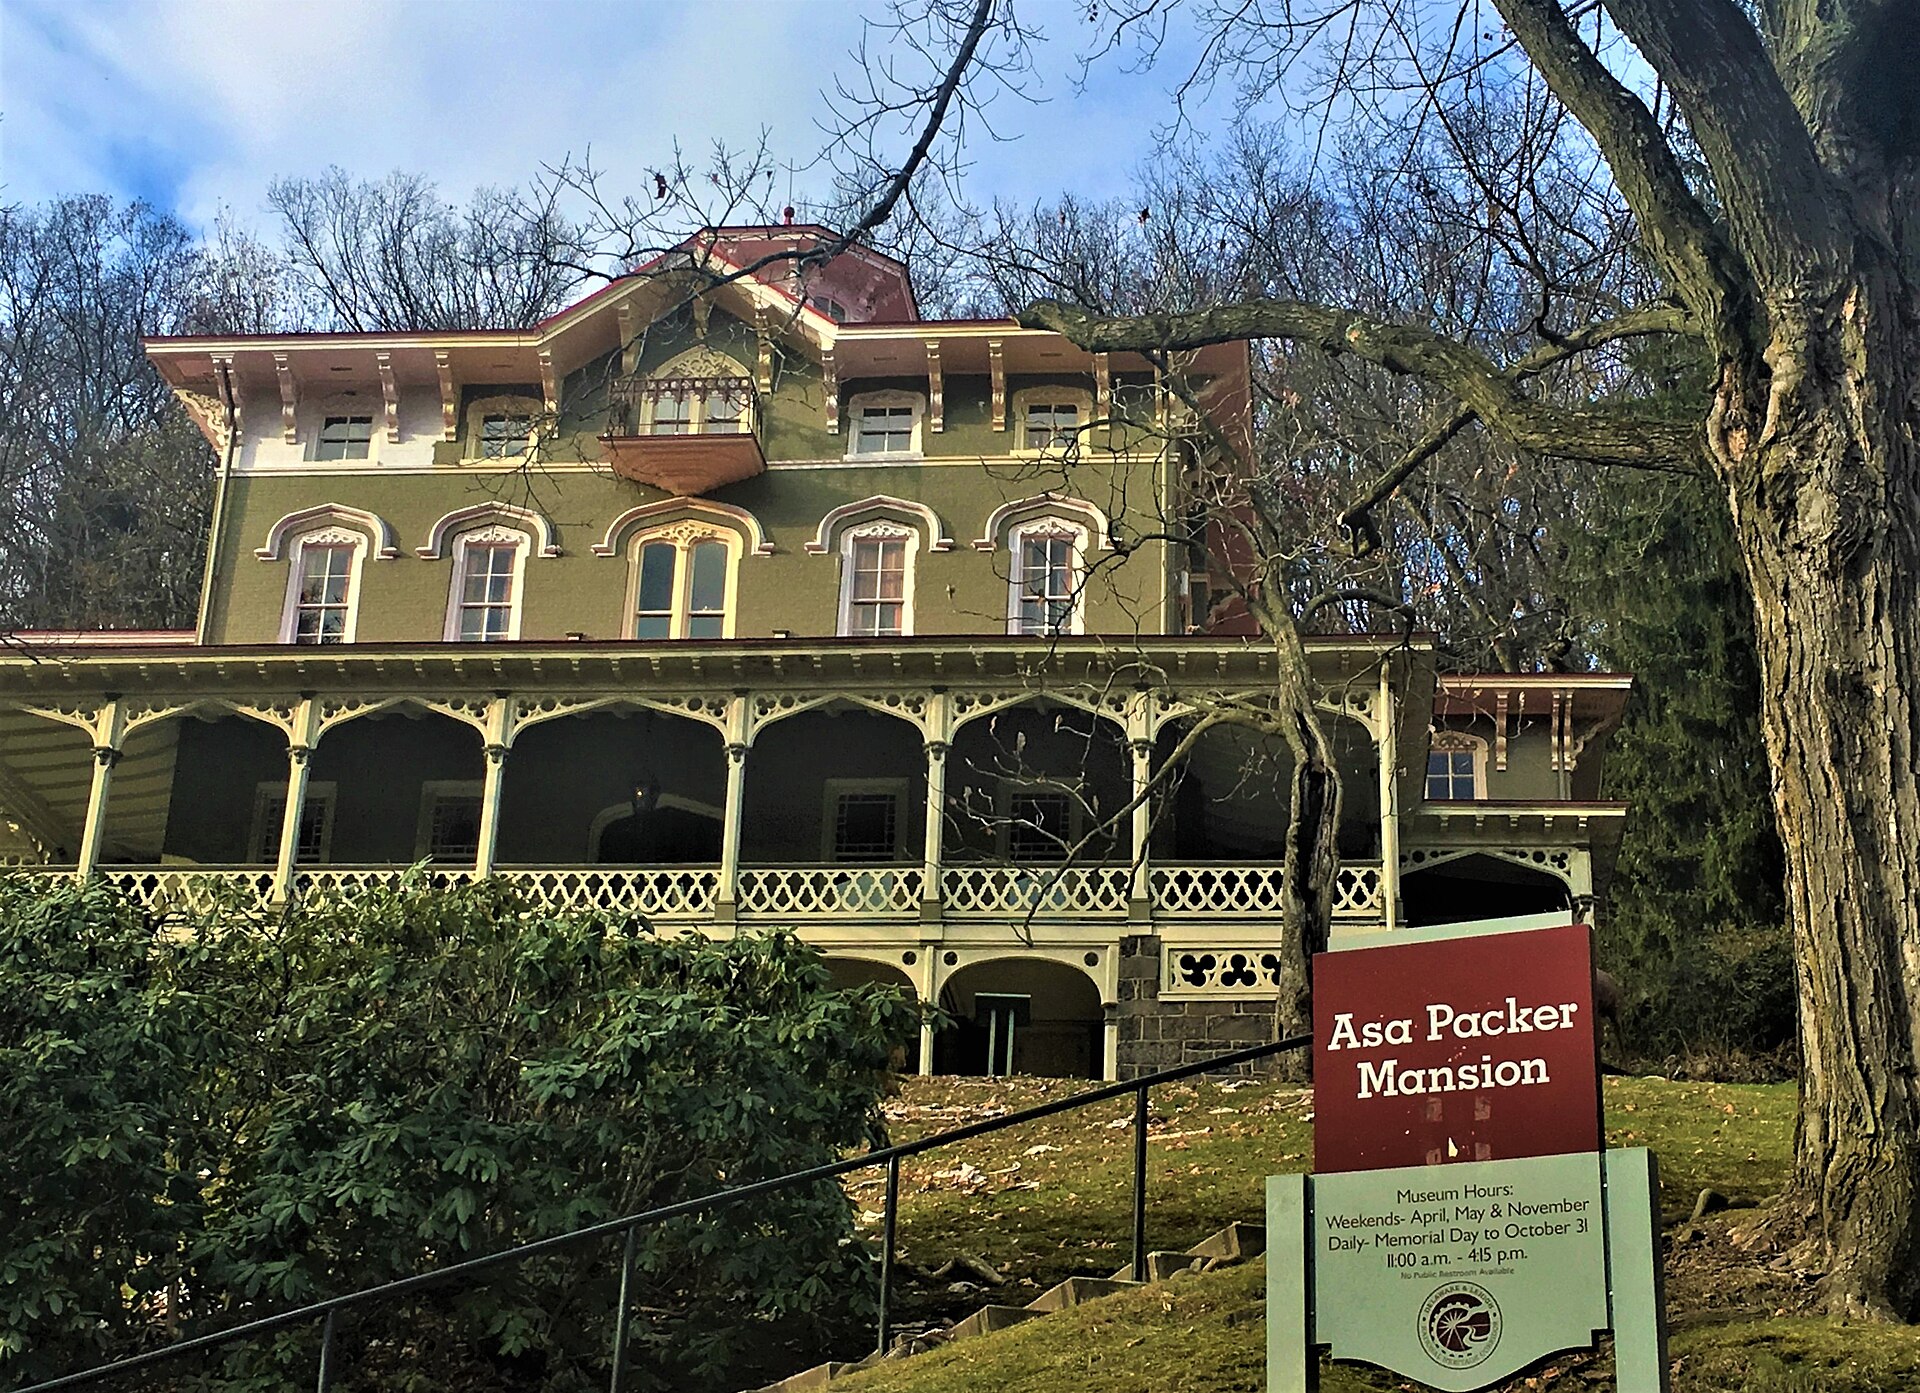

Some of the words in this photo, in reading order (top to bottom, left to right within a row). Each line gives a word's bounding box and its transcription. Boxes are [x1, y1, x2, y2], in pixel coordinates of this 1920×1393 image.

[1327, 1013, 1413, 1050] Asa
[1426, 997, 1578, 1042] Packer
[1357, 1055, 1550, 1099] Mansion
[1397, 1189, 1459, 1204] Museum
[1464, 1184, 1513, 1199] Hours:
[1325, 1212, 1406, 1229] Weekends-
[1410, 1208, 1450, 1227] April,
[1455, 1206, 1485, 1224] May
[1490, 1203, 1502, 1218] &
[1508, 1198, 1589, 1217] November
[1328, 1235, 1369, 1253] Daily-
[1375, 1229, 1444, 1247] Memorial
[1450, 1228, 1479, 1245] Day
[1484, 1229, 1500, 1240] to
[1505, 1221, 1571, 1238] October
[1576, 1218, 1588, 1233] 31
[1387, 1252, 1416, 1268] 11:00
[1421, 1254, 1451, 1266] a.m.
[1468, 1247, 1492, 1262] 4:15
[1497, 1249, 1528, 1265] p.m.
[1401, 1271, 1411, 1279] No
[1414, 1271, 1437, 1279] Public
[1479, 1267, 1515, 1275] Available
[1425, 1285, 1459, 1313] DELAWARE
[1470, 1285, 1494, 1309] LEHIGH
